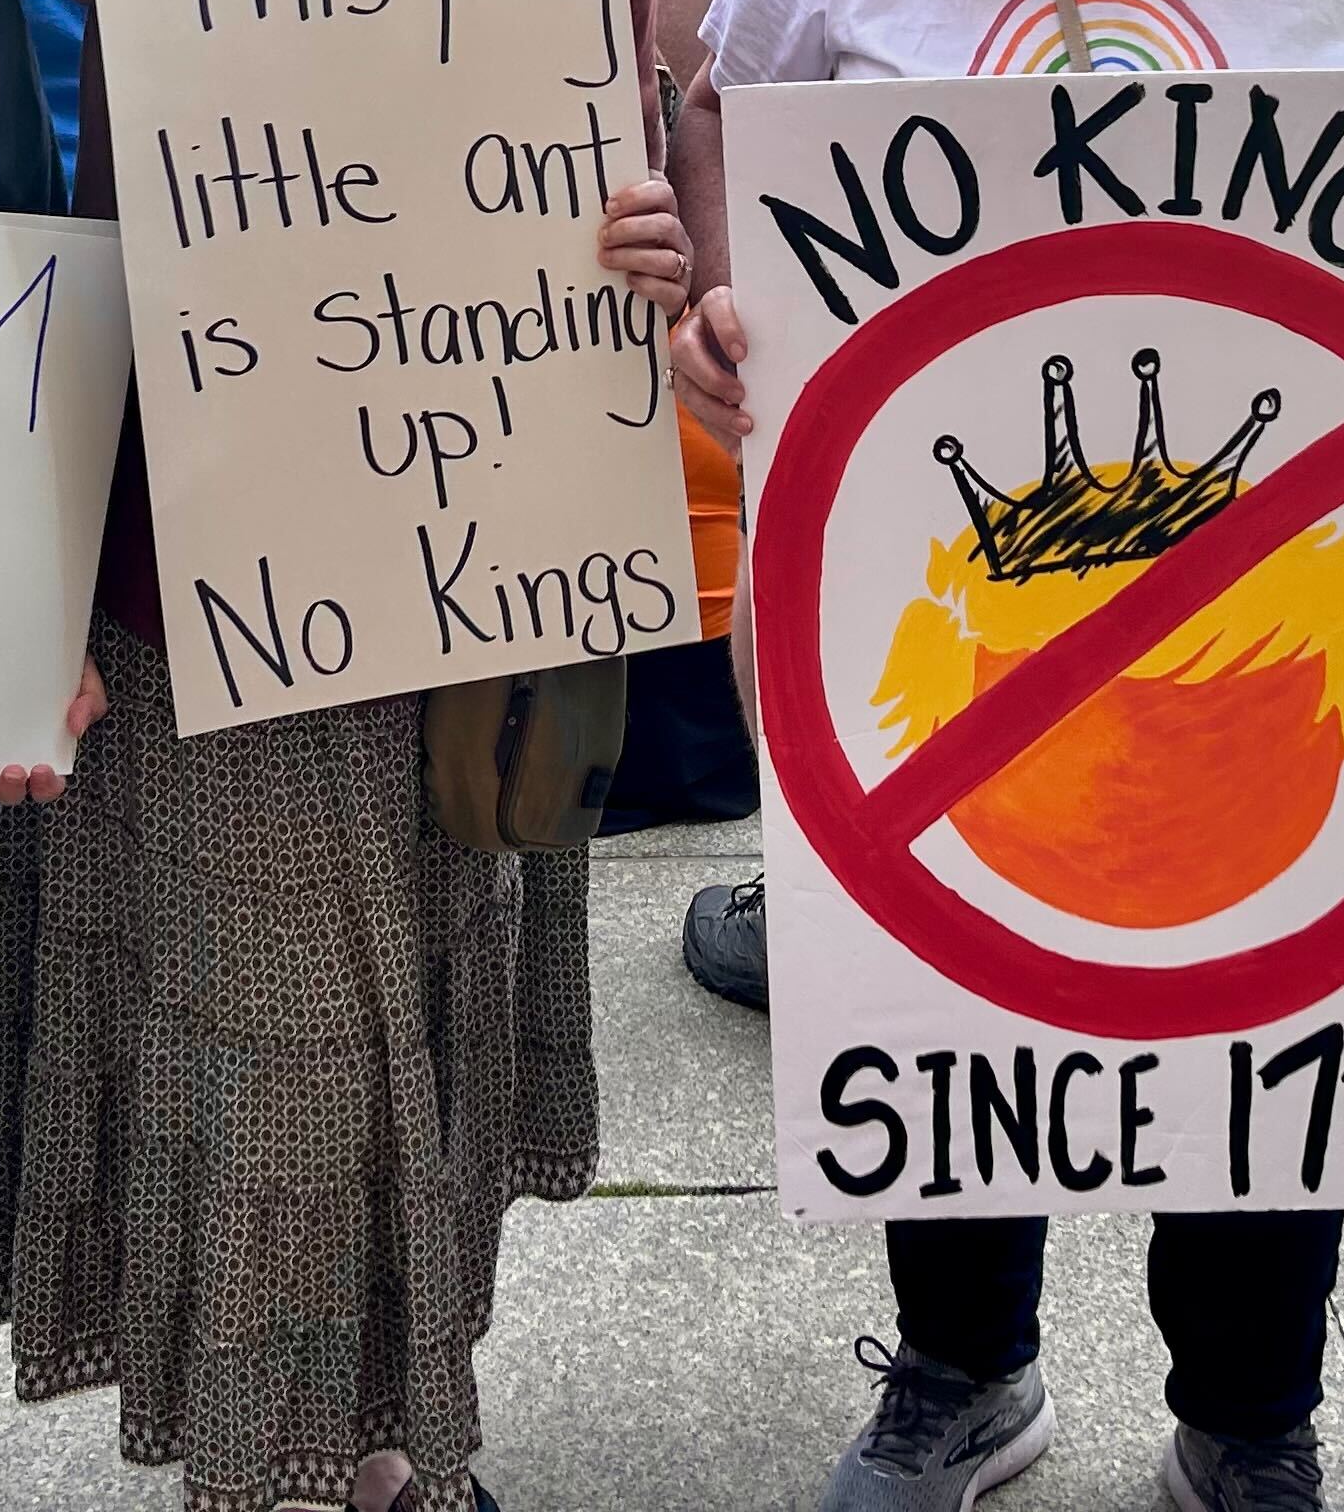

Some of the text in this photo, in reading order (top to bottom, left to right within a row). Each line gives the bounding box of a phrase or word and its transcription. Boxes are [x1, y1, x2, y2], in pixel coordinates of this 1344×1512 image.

[157, 101, 623, 249] little ant
[758, 112, 982, 326] NO
[179, 310, 260, 394] is
[358, 375, 515, 510] up!
[193, 520, 676, 709] No Kings
[815, 1044, 1167, 1199] SINCE
